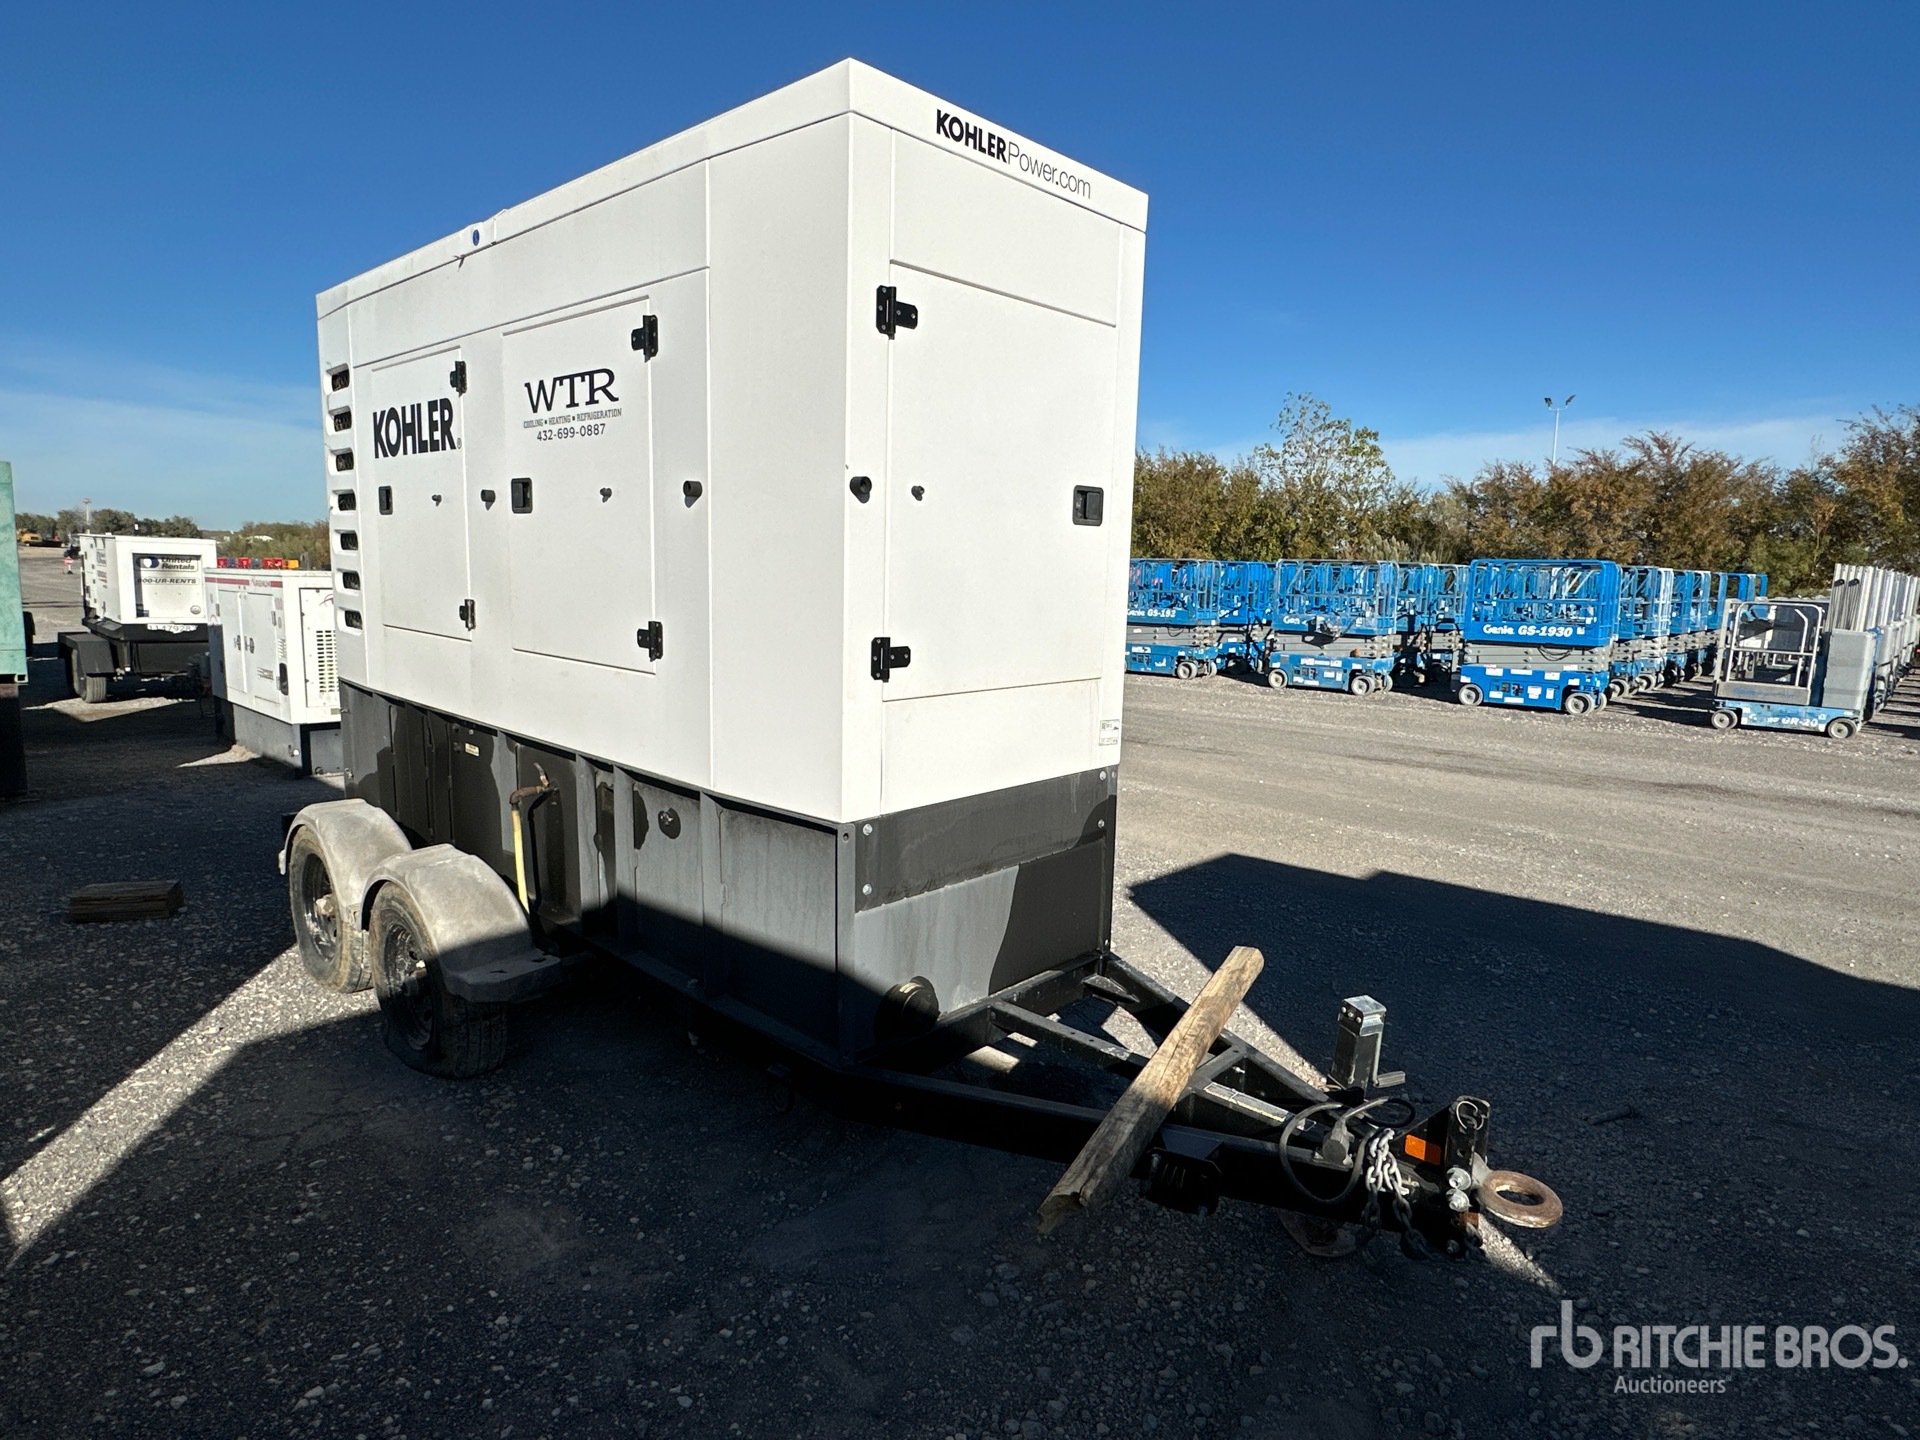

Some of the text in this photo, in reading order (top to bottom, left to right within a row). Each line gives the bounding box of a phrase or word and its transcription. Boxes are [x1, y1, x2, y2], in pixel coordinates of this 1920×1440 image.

[936, 108, 1092, 199] KOHLERPower.com
[524, 367, 620, 414] WTR
[372, 397, 457, 459] KOHLER
[523, 408, 622, 428] COOLING HEATING REFRIGERATION
[536, 423, 606, 441] 432-699-0887
[161, 556, 192, 564] United
[1483, 624, 1573, 637] Genie GS-1930
